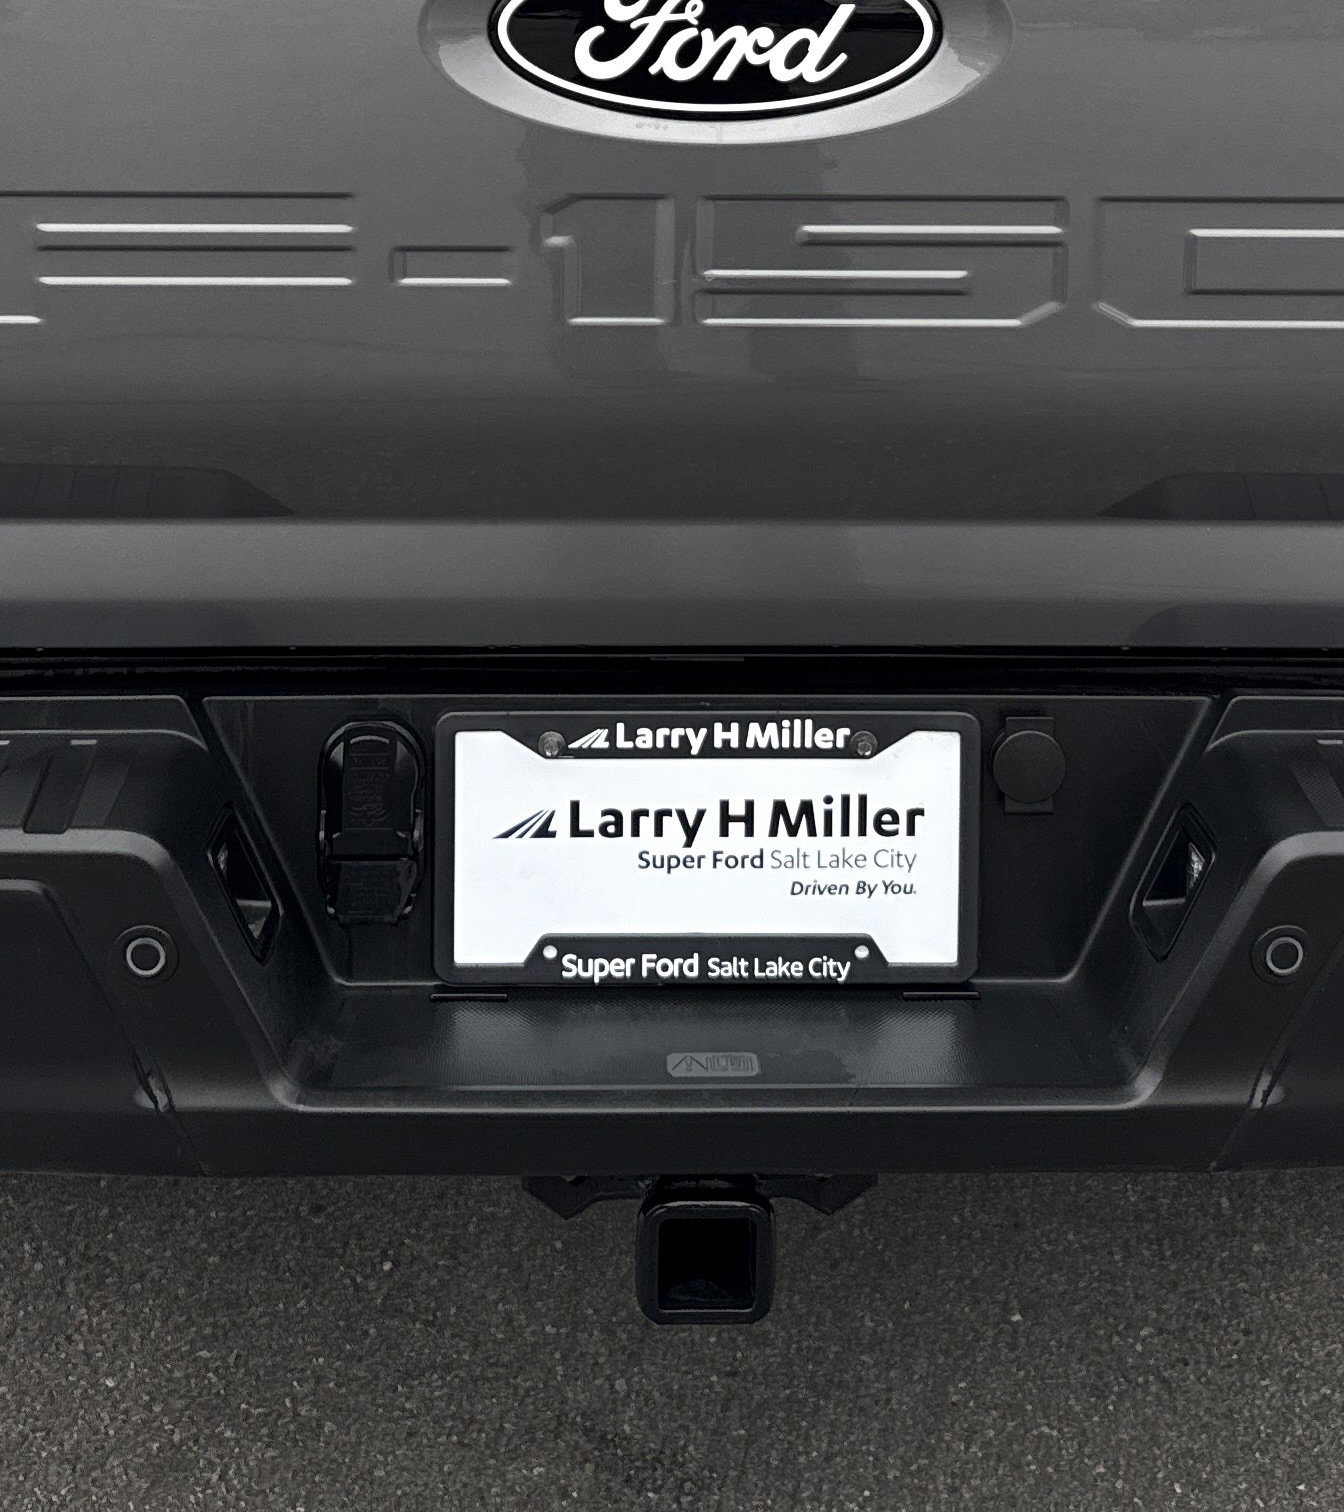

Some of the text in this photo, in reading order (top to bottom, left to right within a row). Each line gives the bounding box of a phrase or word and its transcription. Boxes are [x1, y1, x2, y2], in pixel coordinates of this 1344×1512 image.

[616, 719, 851, 756] Larry H Miller
[569, 793, 925, 849] Larry H Miller
[637, 847, 917, 874] Super Ford Salt Lake City
[789, 879, 850, 896] Driven
[855, 880, 878, 899] By
[561, 952, 851, 984] Super Ford Salt Lake City
